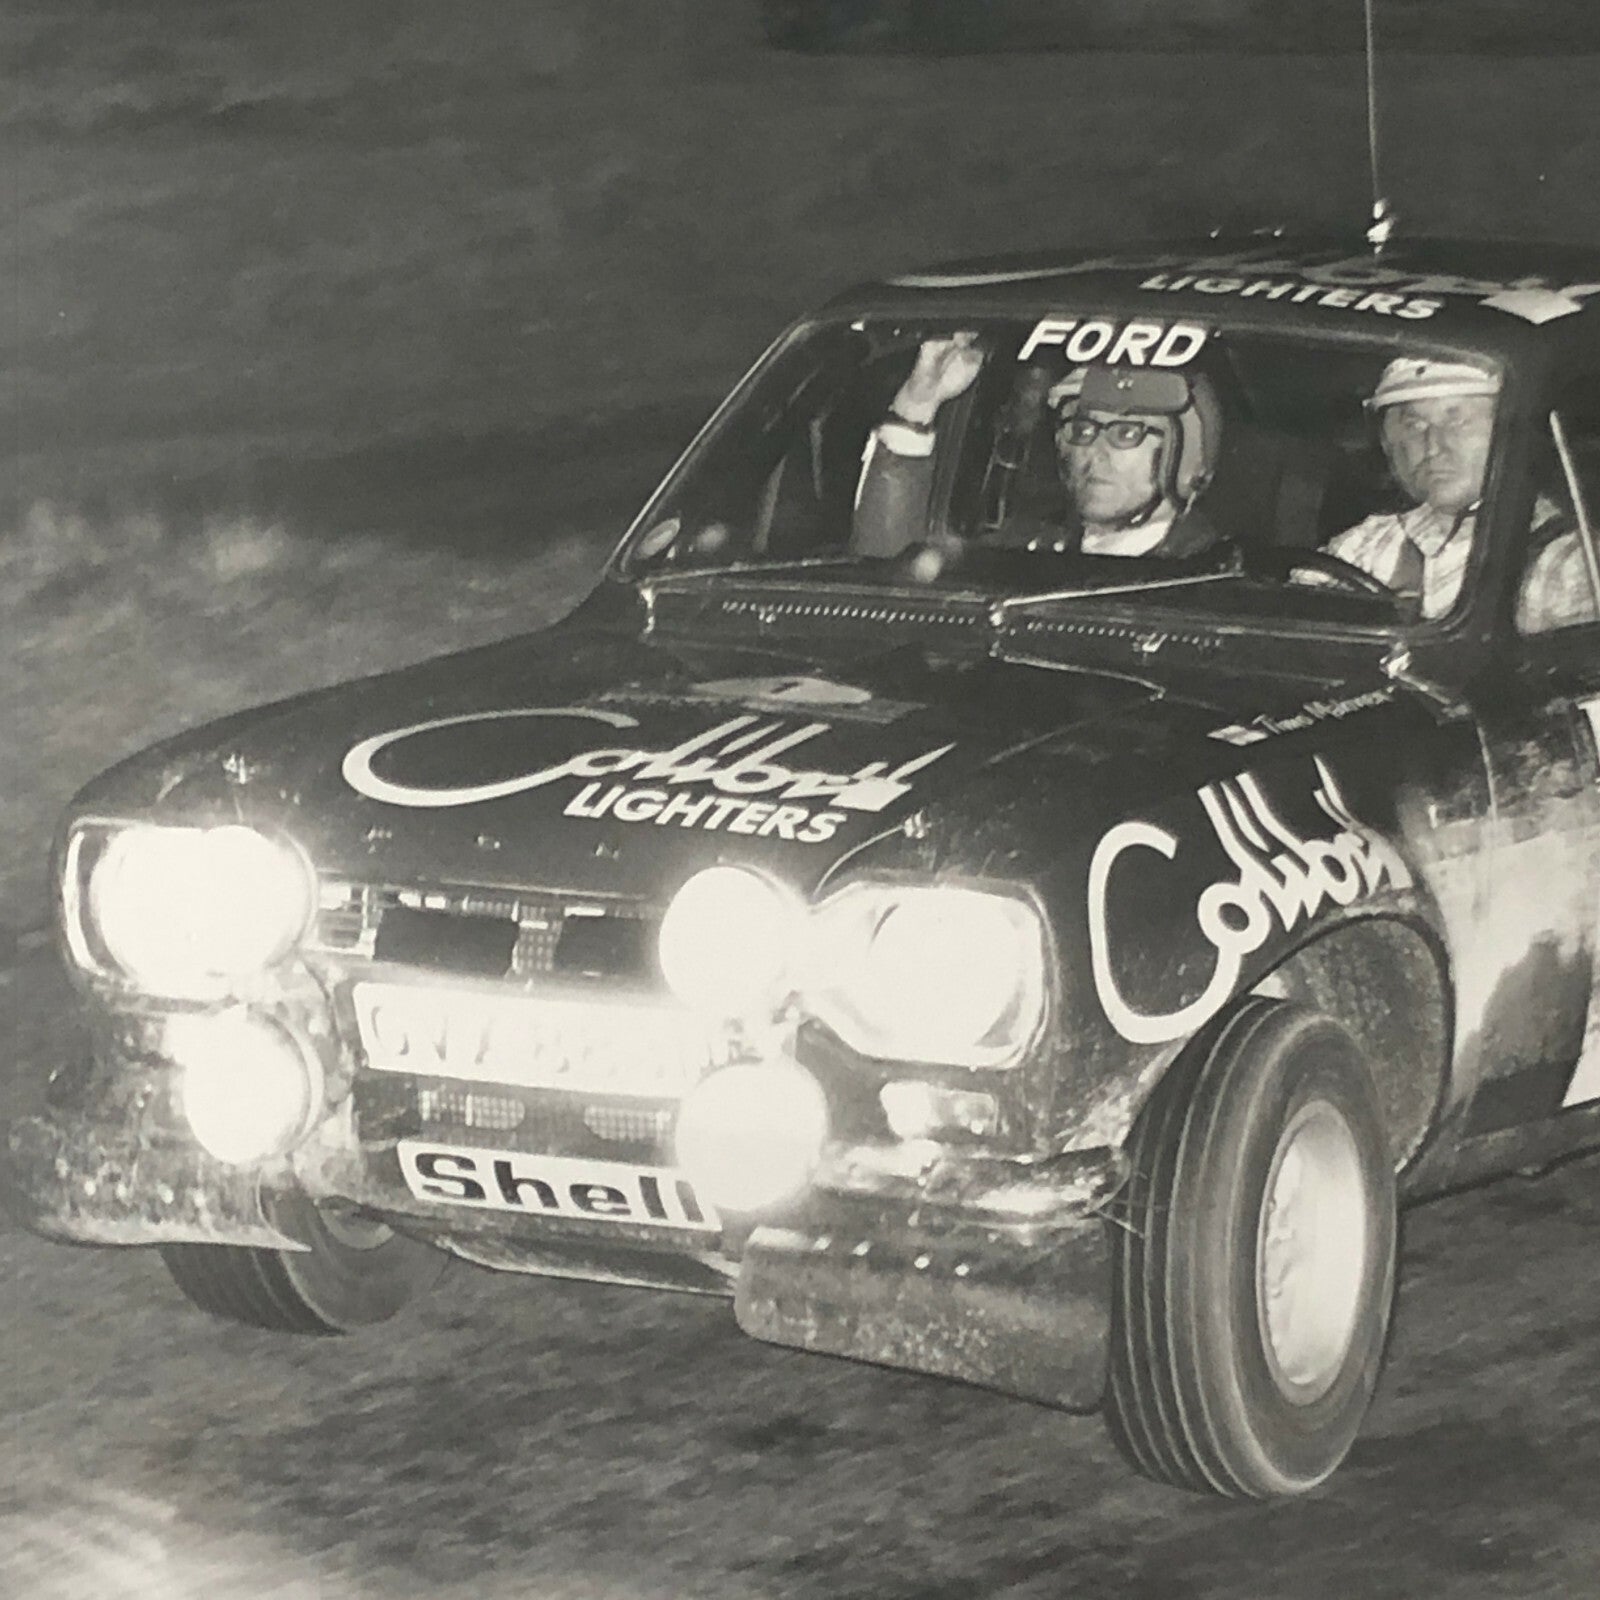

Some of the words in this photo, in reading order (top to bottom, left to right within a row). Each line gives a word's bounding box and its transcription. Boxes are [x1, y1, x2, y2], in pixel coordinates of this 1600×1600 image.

[1140, 274, 1443, 320] LIGHTERS
[1017, 318, 1208, 368] FORD
[564, 782, 848, 843] LIGHTERS
[414, 1151, 704, 1223] Shell
